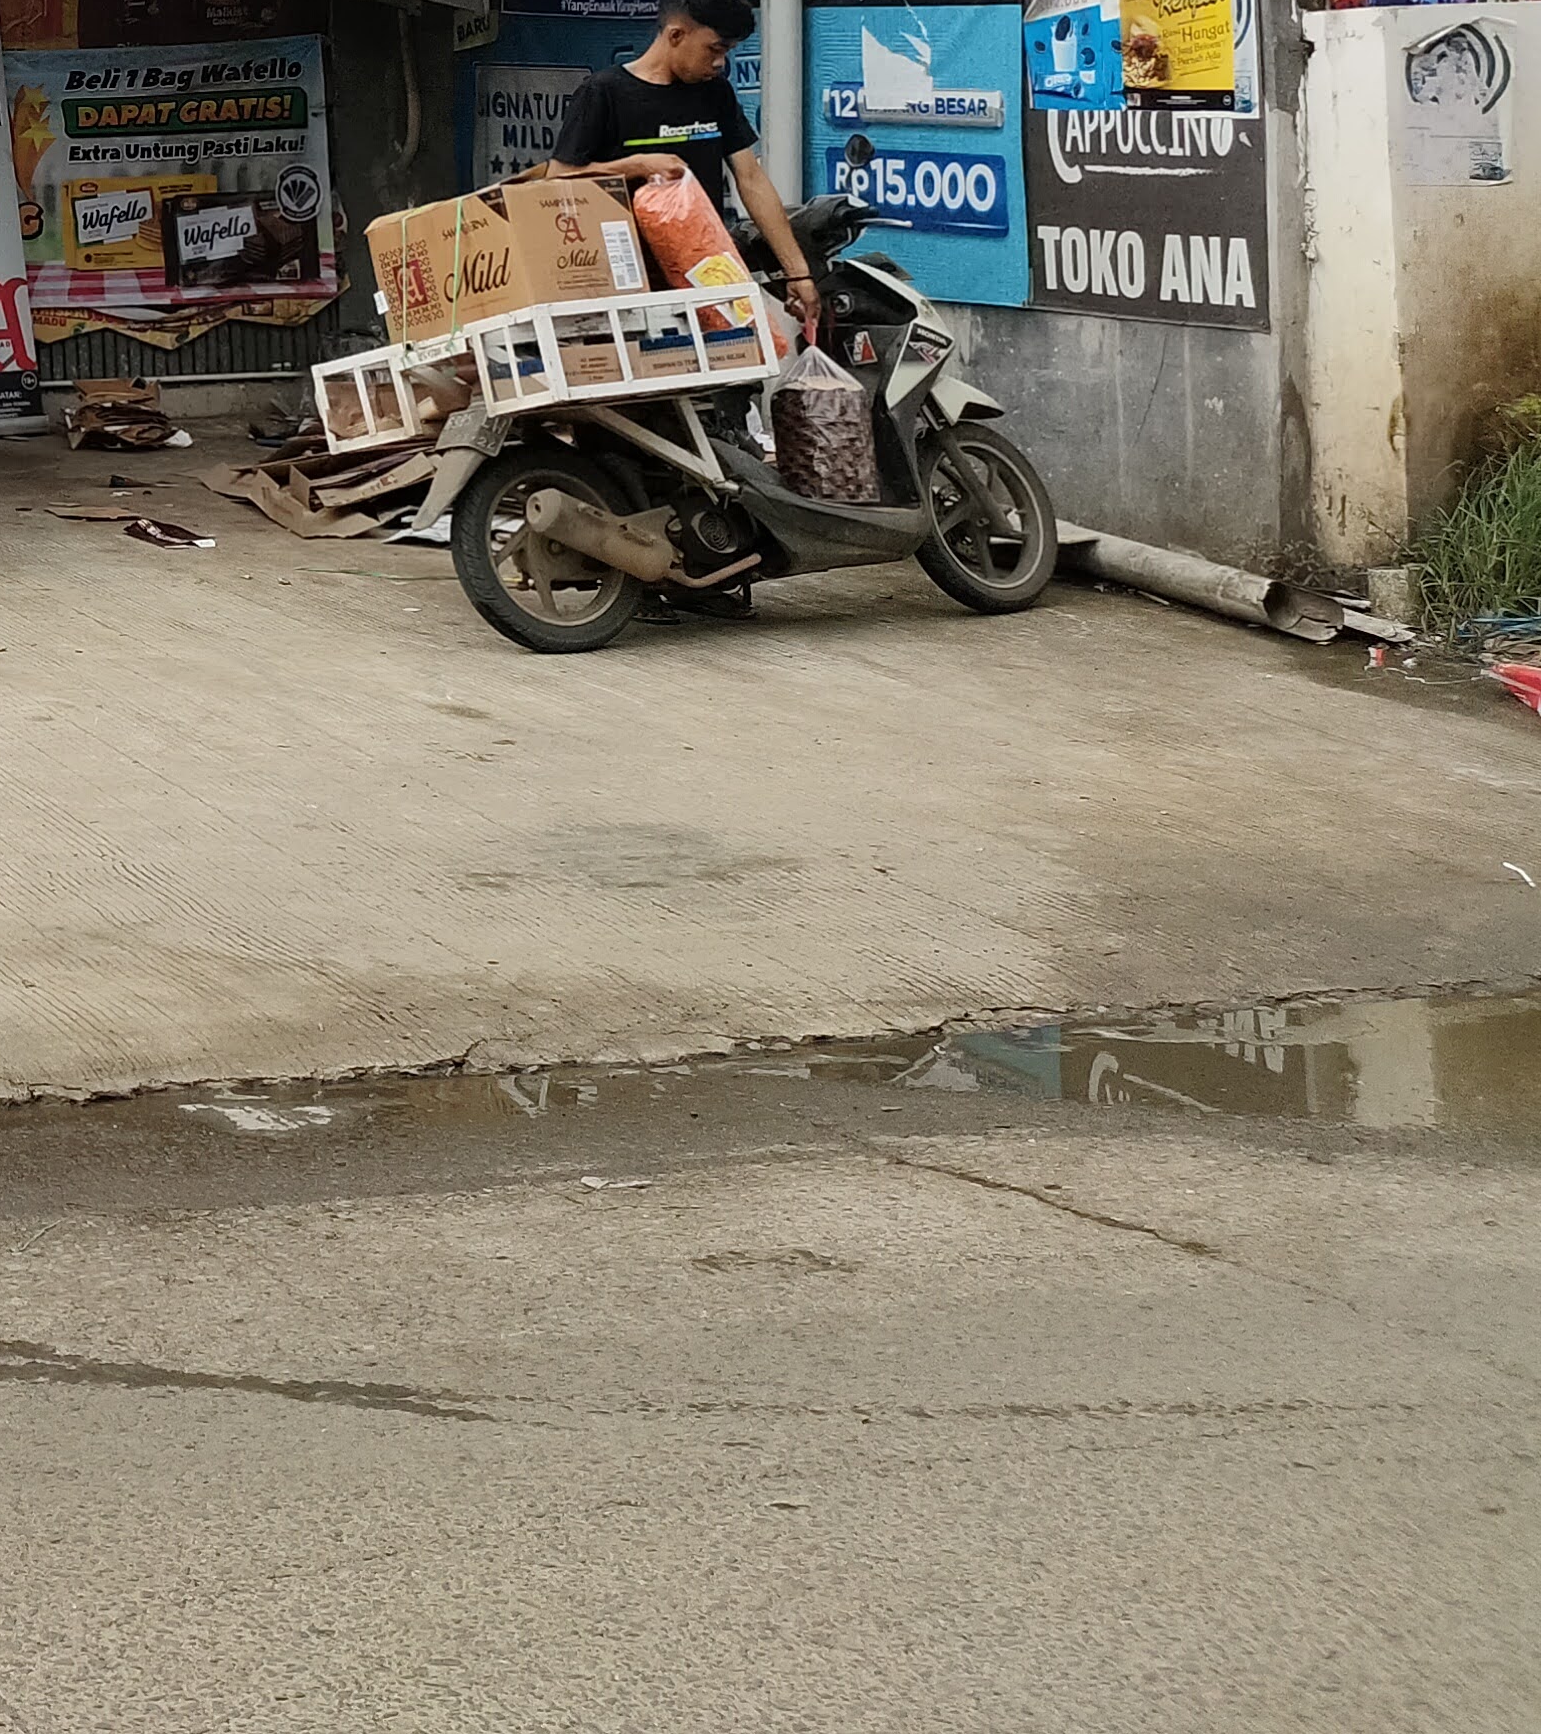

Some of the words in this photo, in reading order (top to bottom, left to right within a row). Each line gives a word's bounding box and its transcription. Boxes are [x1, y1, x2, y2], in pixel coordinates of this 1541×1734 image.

[1181, 21, 1231, 43] Hangat
[64, 66, 121, 91] Beli
[125, 68, 139, 88] 1
[141, 67, 195, 92] Bag
[199, 57, 303, 84] Wafello
[76, 100, 177, 128] DAPAT
[178, 94, 293, 124] GRATIS!
[934, 97, 989, 117] BESAR
[68, 145, 122, 162] Extra
[124, 141, 199, 164] Untung
[202, 136, 250, 157] Pasti
[251, 134, 306, 154] Laku!
[502, 123, 555, 150] MILD
[81, 200, 148, 234] Wafello
[183, 215, 251, 251] Wafello
[443, 246, 512, 303] Mild
[556, 248, 600, 270] Mild
[1037, 224, 1147, 301] TOKO
[1158, 233, 1258, 309] ANA
[915, 326, 949, 346] HONDA
